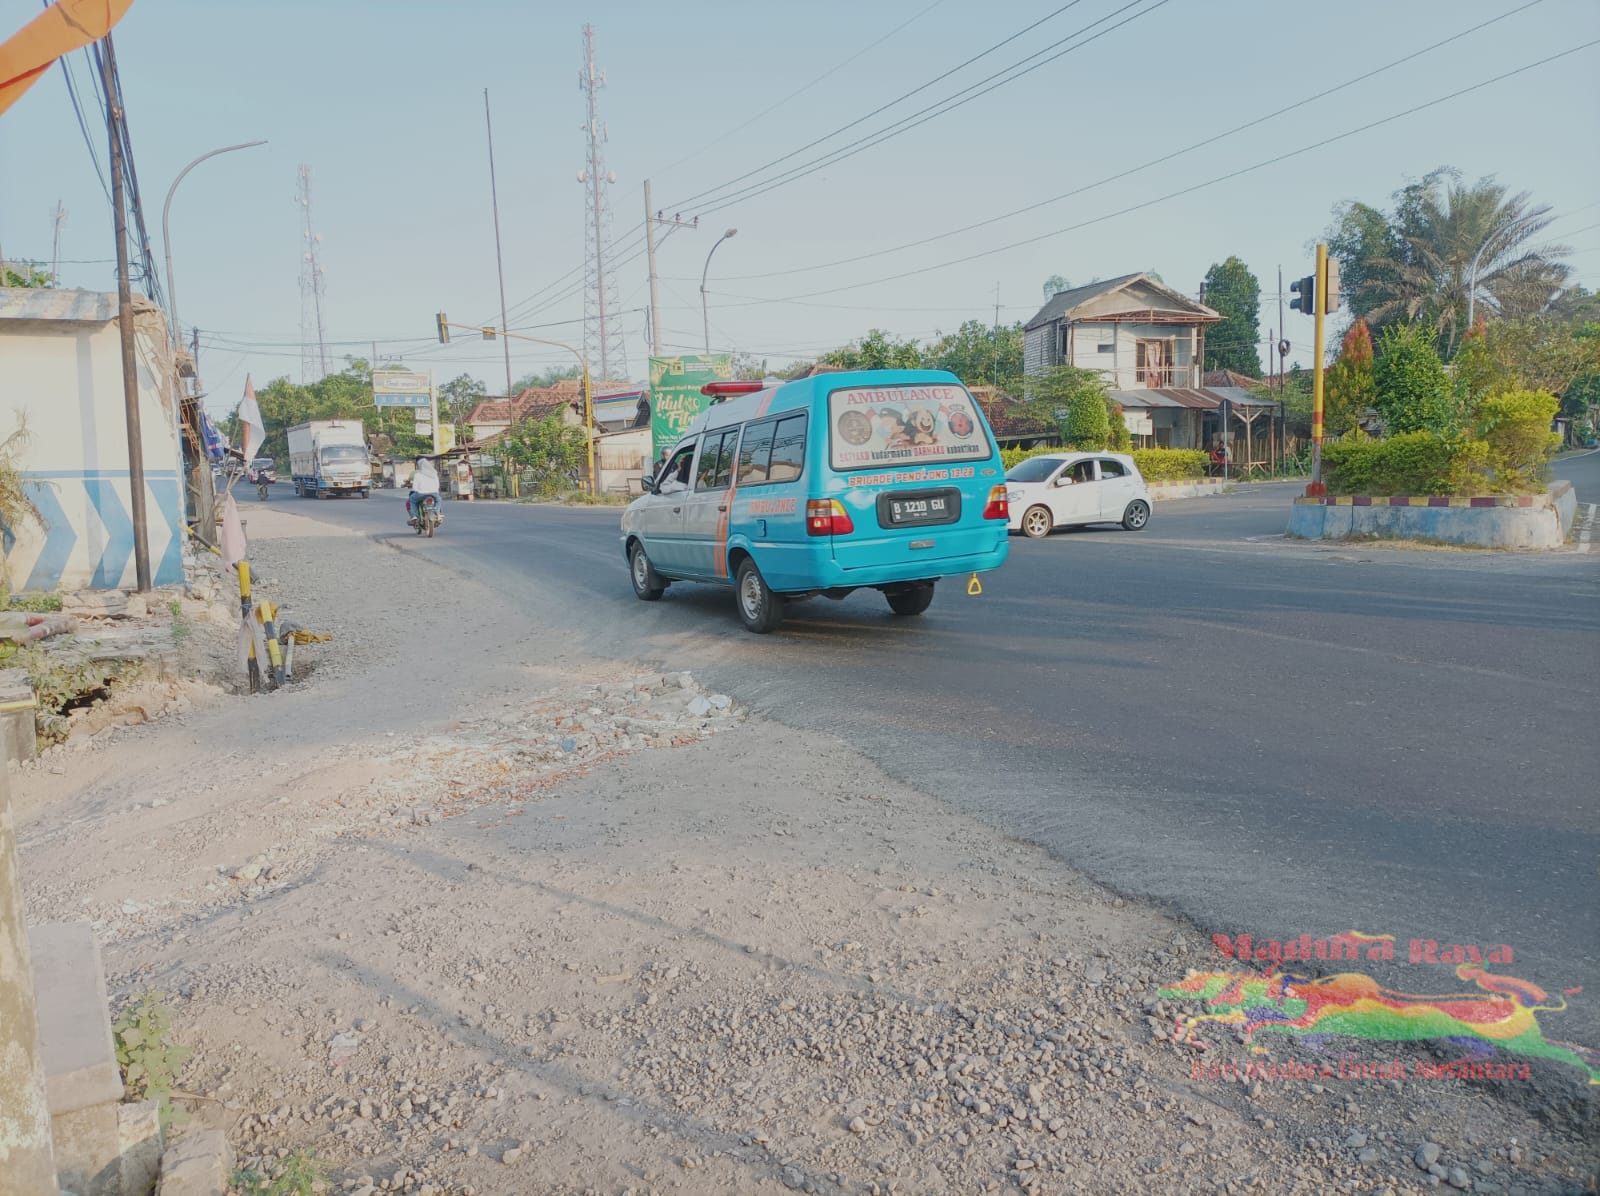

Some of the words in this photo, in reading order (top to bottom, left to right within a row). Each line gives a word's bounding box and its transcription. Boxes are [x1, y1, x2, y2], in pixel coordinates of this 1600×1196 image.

[847, 388, 954, 405] AMBULANCE
[849, 474, 892, 487] BRIGADE
[895, 469, 947, 483] PENOONG
[893, 502, 901, 514] B
